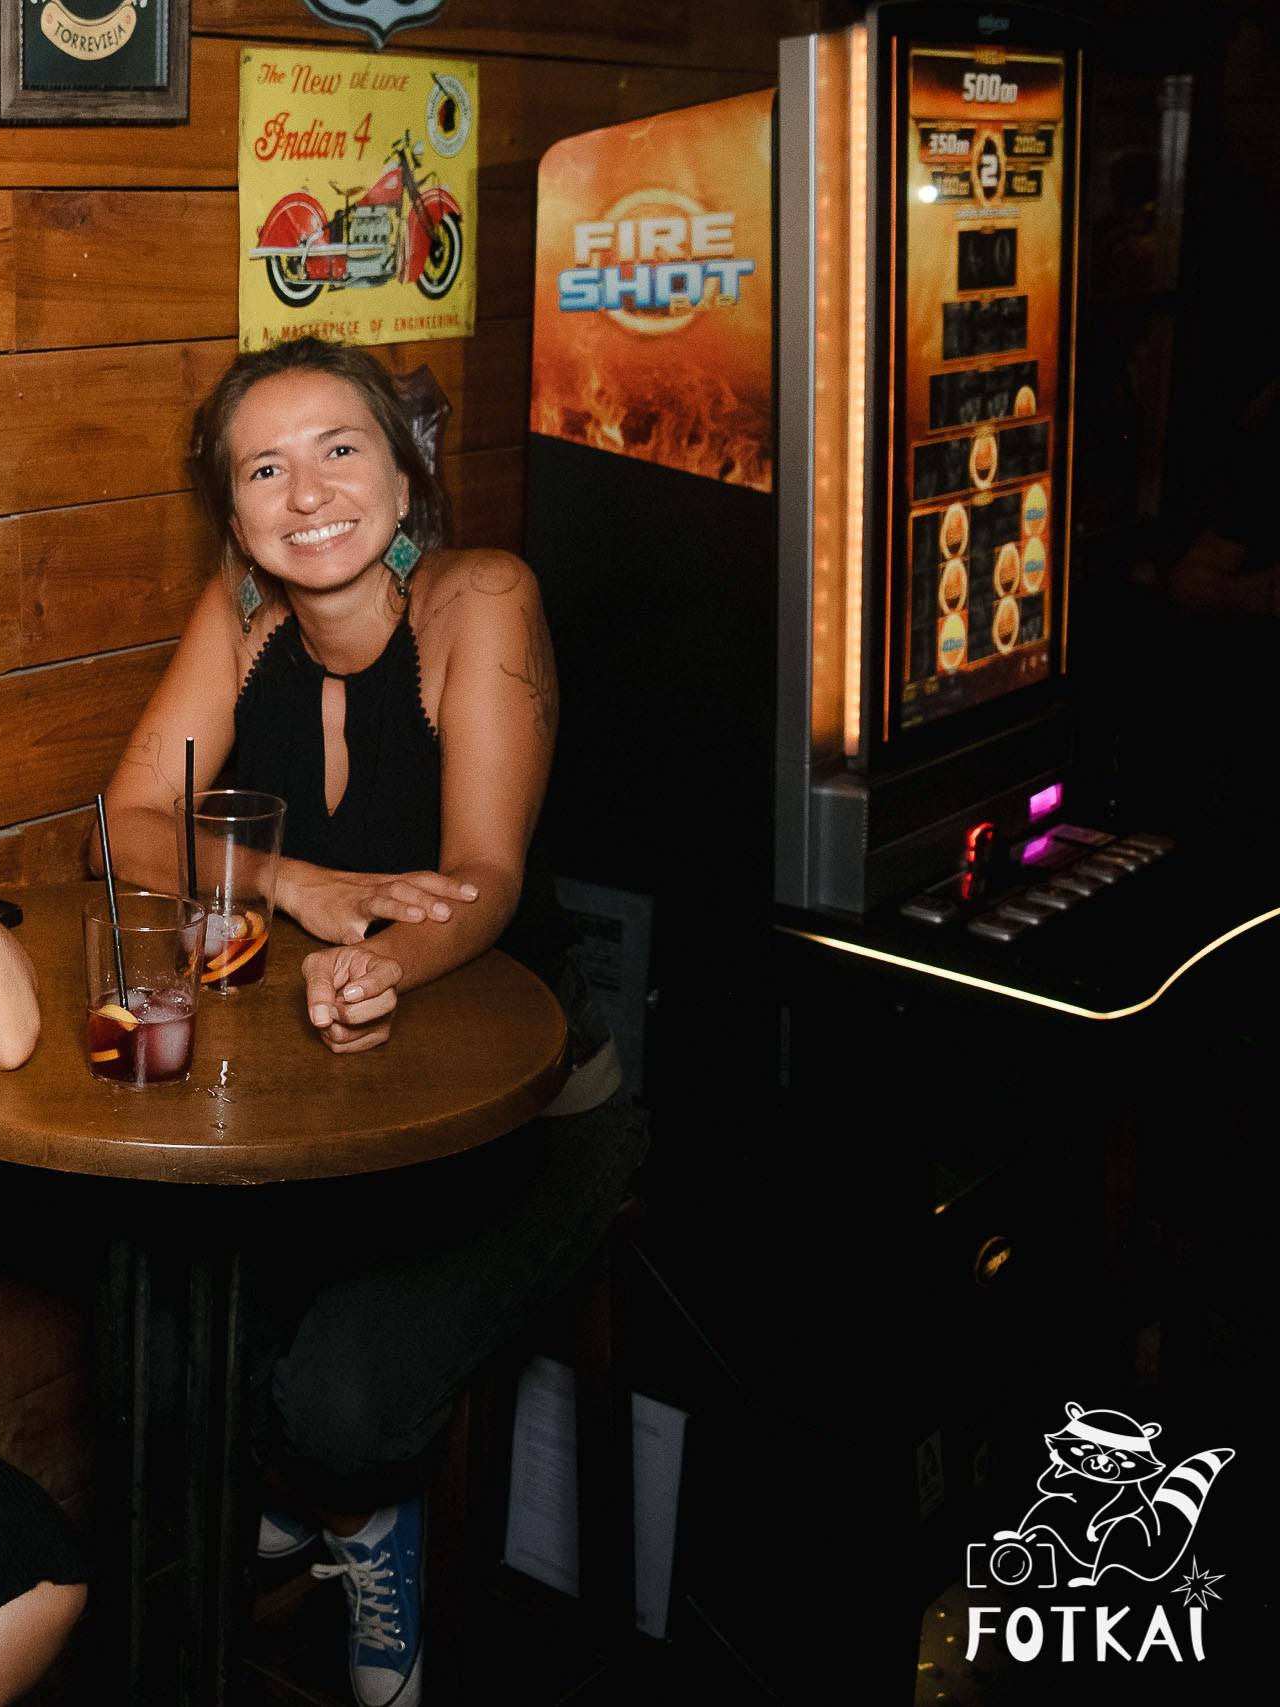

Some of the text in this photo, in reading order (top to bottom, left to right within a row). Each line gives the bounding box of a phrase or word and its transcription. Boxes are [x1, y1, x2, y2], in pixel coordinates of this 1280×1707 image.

[55, 21, 126, 52] TORREVIEJA
[257, 64, 285, 85] The
[290, 64, 342, 95] New
[254, 111, 347, 162] Indian
[354, 112, 372, 161] 4
[981, 154, 998, 188] 2
[574, 212, 735, 264] FIRE
[558, 259, 756, 313] SHOT
[370, 318, 384, 332] OF
